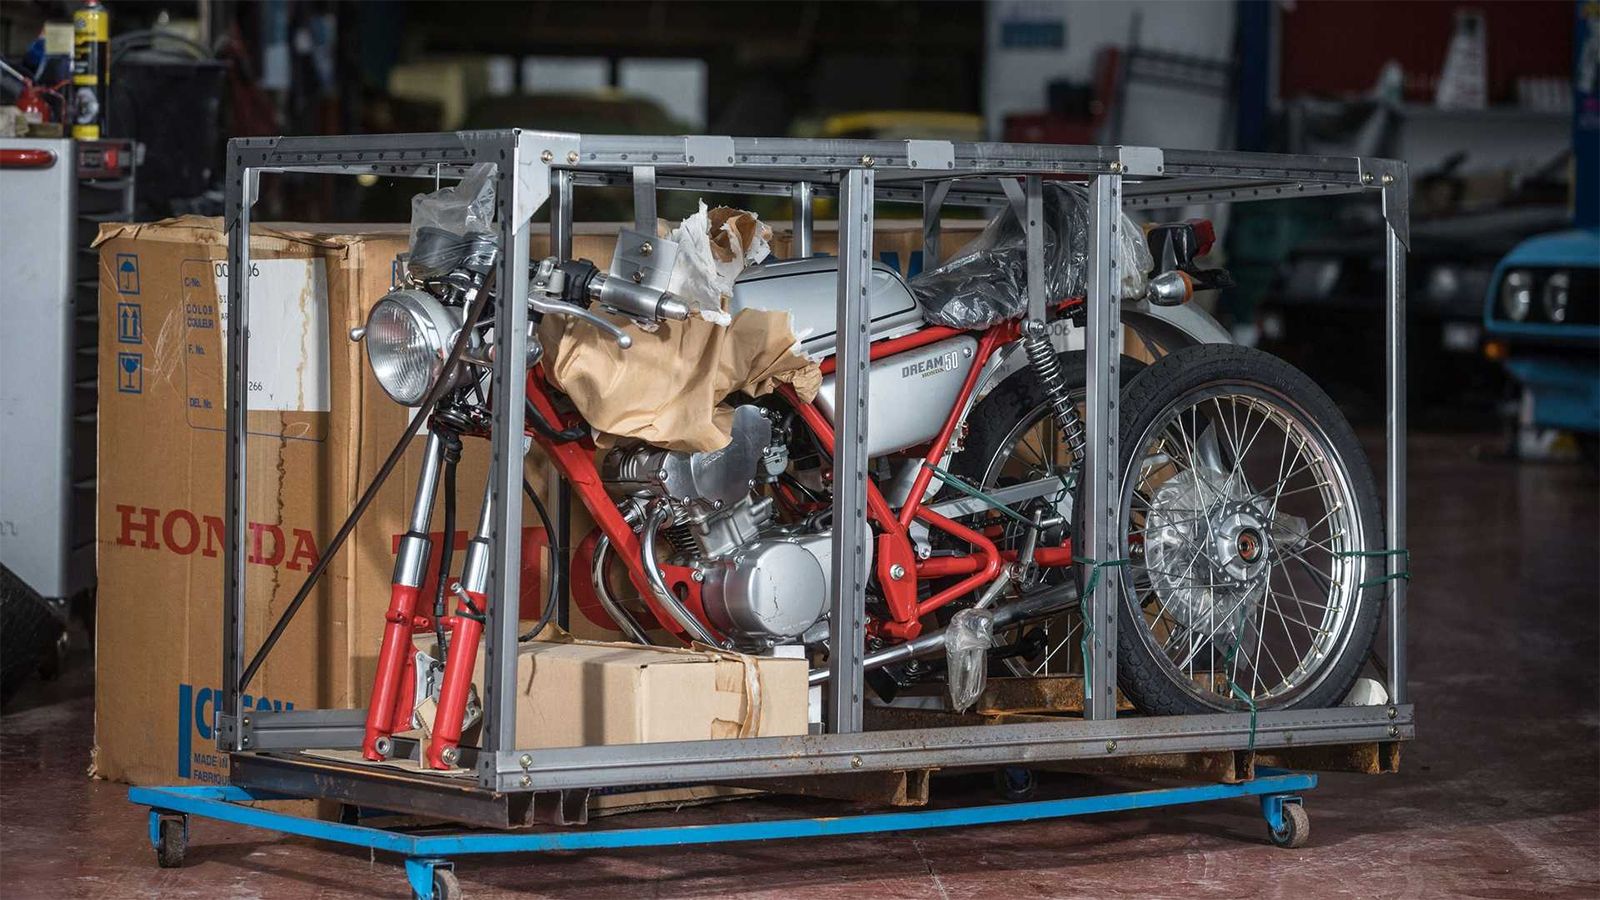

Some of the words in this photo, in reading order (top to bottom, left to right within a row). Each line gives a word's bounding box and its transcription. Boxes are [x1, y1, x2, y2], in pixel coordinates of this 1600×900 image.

[215, 263, 259, 277] 0006
[186, 303, 213, 315] COLOR
[187, 317, 214, 329] COULEUR
[902, 355, 943, 378] DREAM
[944, 350, 959, 371] 50
[193, 753, 217, 767] MADE
[219, 756, 228, 768] IN
